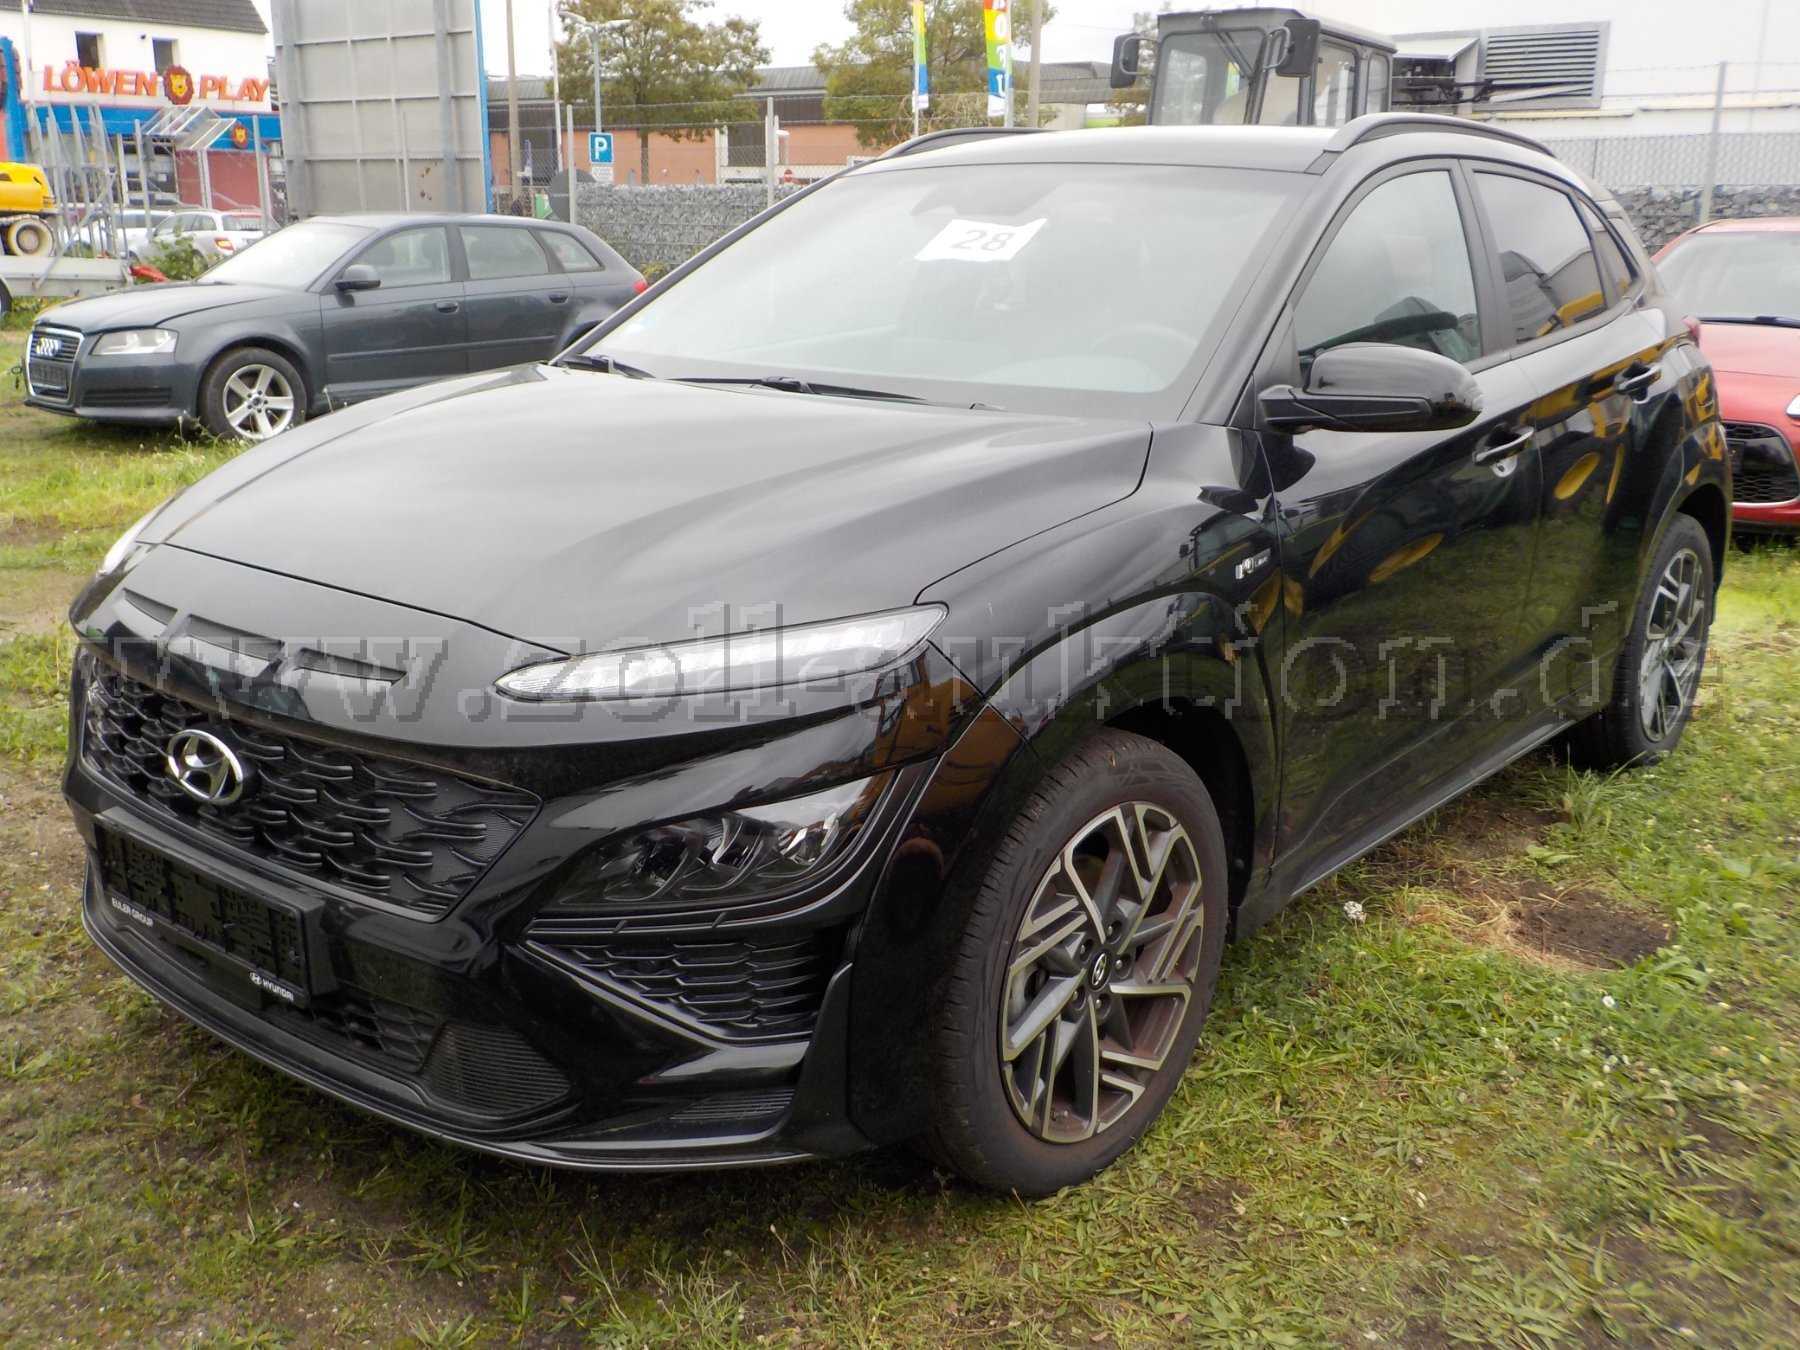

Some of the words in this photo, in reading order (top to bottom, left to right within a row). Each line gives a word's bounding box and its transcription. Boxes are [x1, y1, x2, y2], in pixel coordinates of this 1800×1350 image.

[44, 60, 158, 97] LÖWEN
[199, 74, 269, 102] PLAY
[594, 136, 608, 160] P
[950, 229, 1016, 251] 28
